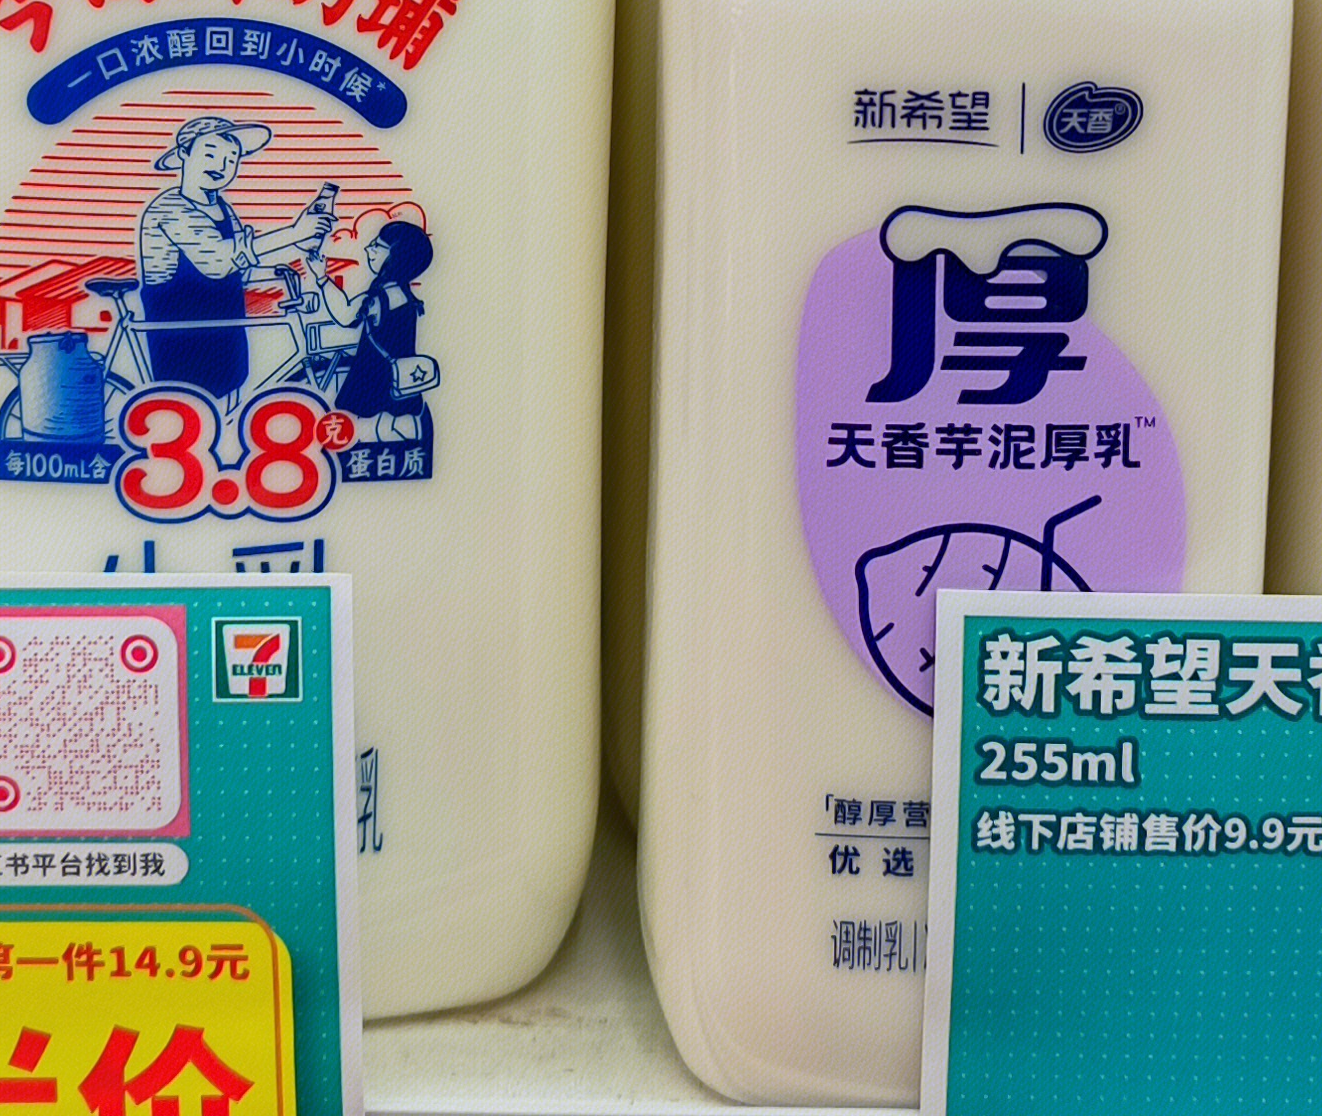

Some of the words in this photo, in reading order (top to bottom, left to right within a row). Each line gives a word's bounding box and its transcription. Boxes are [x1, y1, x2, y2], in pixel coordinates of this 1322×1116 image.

[68, 26, 373, 103] 一口浓醇回到小时候
[854, 88, 990, 132] 新希望
[865, 202, 1108, 405] 厚
[122, 399, 320, 511] 3.8
[346, 446, 426, 479] 蛋白质
[826, 421, 1141, 471] 天香芋泥厚乳
[979, 741, 1135, 782] 255ml
